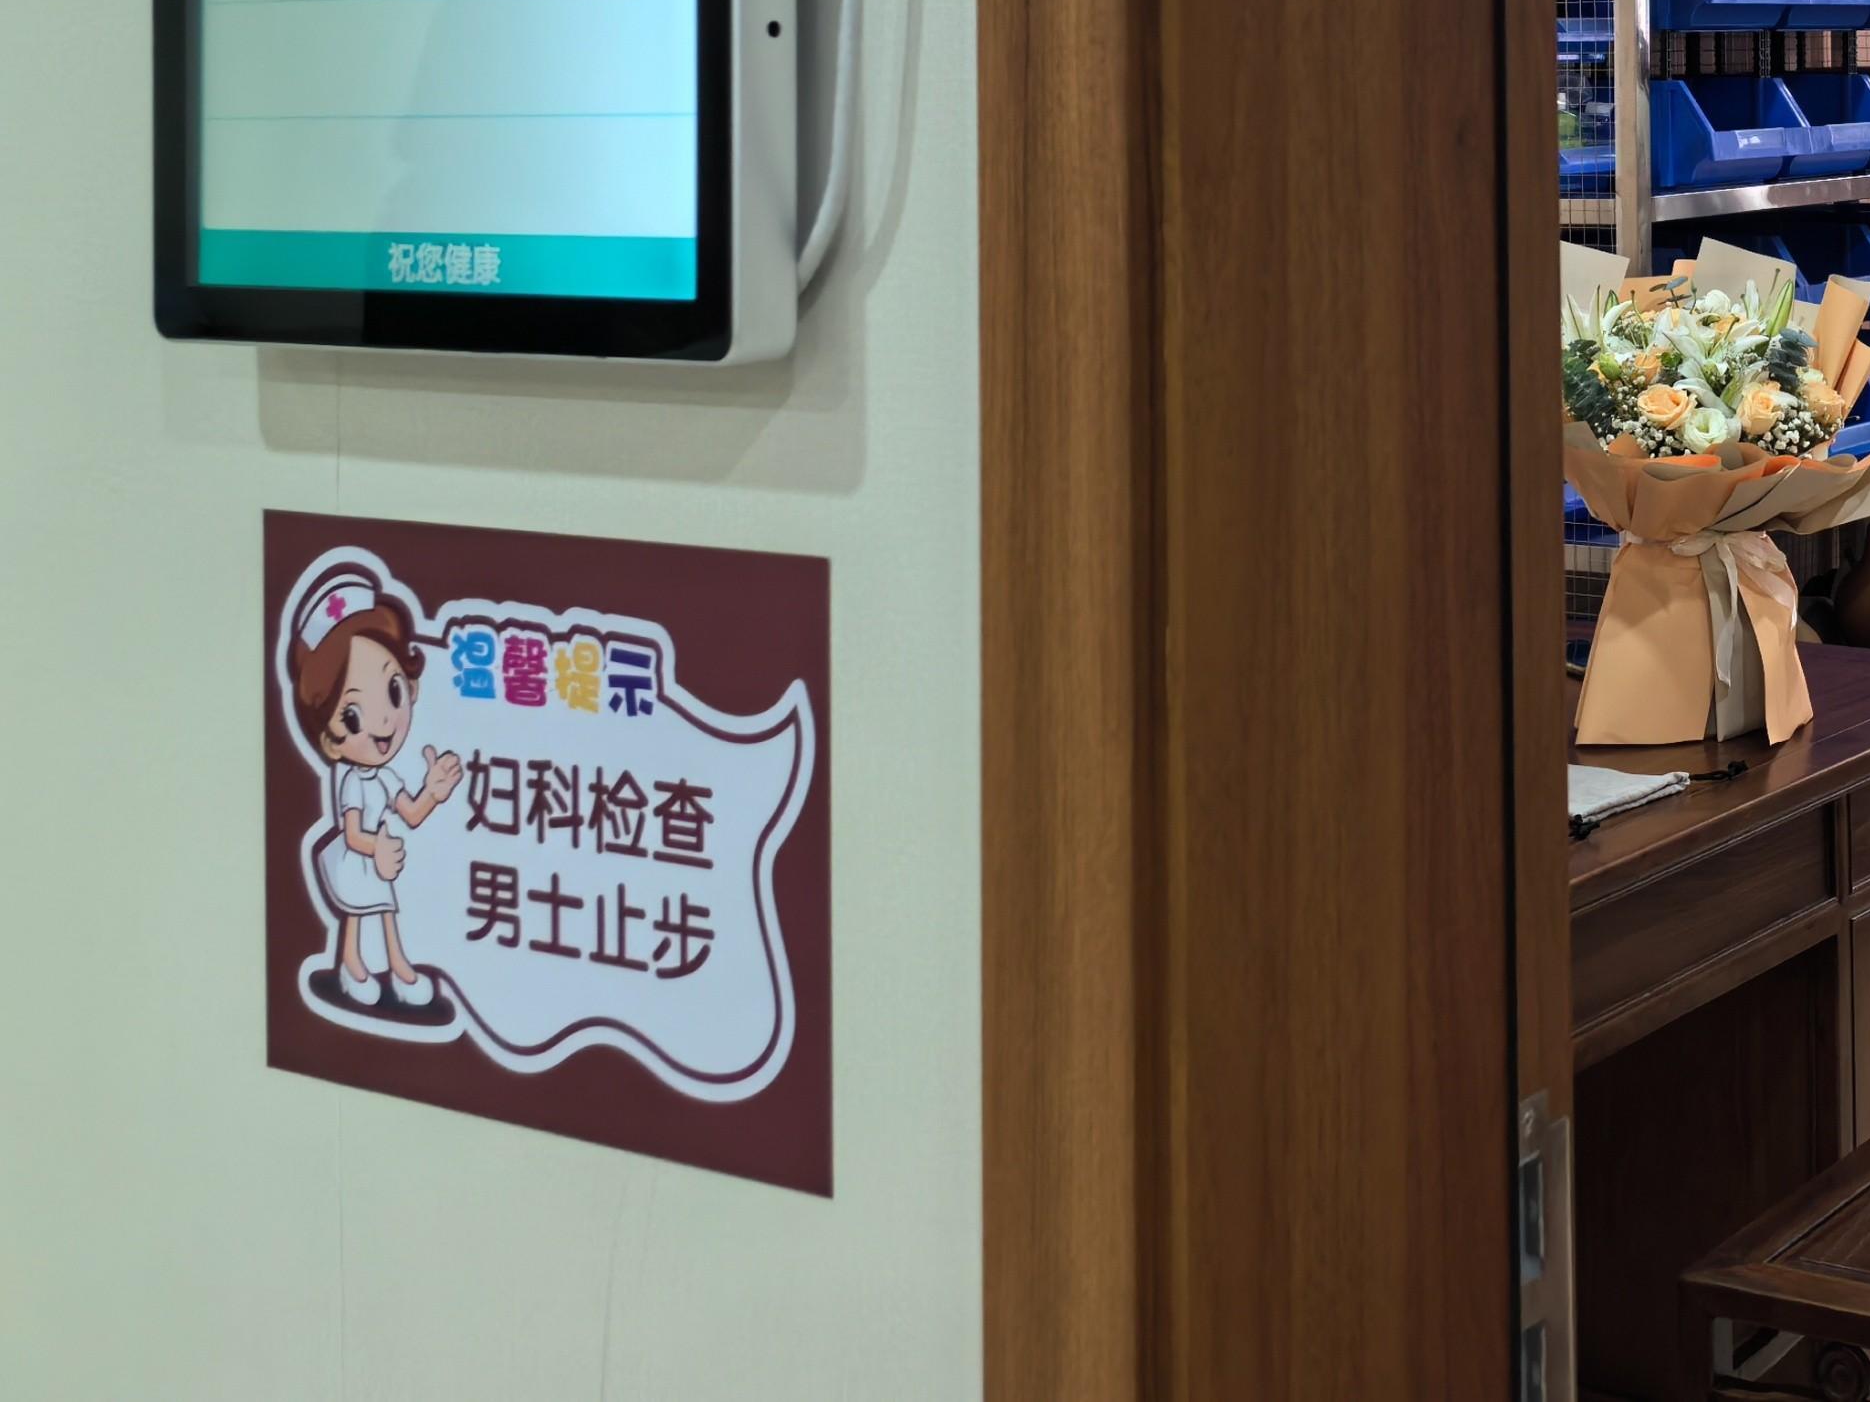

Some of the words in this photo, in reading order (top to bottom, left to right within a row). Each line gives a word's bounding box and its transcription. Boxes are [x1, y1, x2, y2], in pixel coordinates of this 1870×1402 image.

[388, 241, 502, 286] 祝您健康
[451, 631, 654, 717] 温馨提示
[466, 749, 714, 870] 妇科检查
[466, 859, 715, 981] 男士止步
